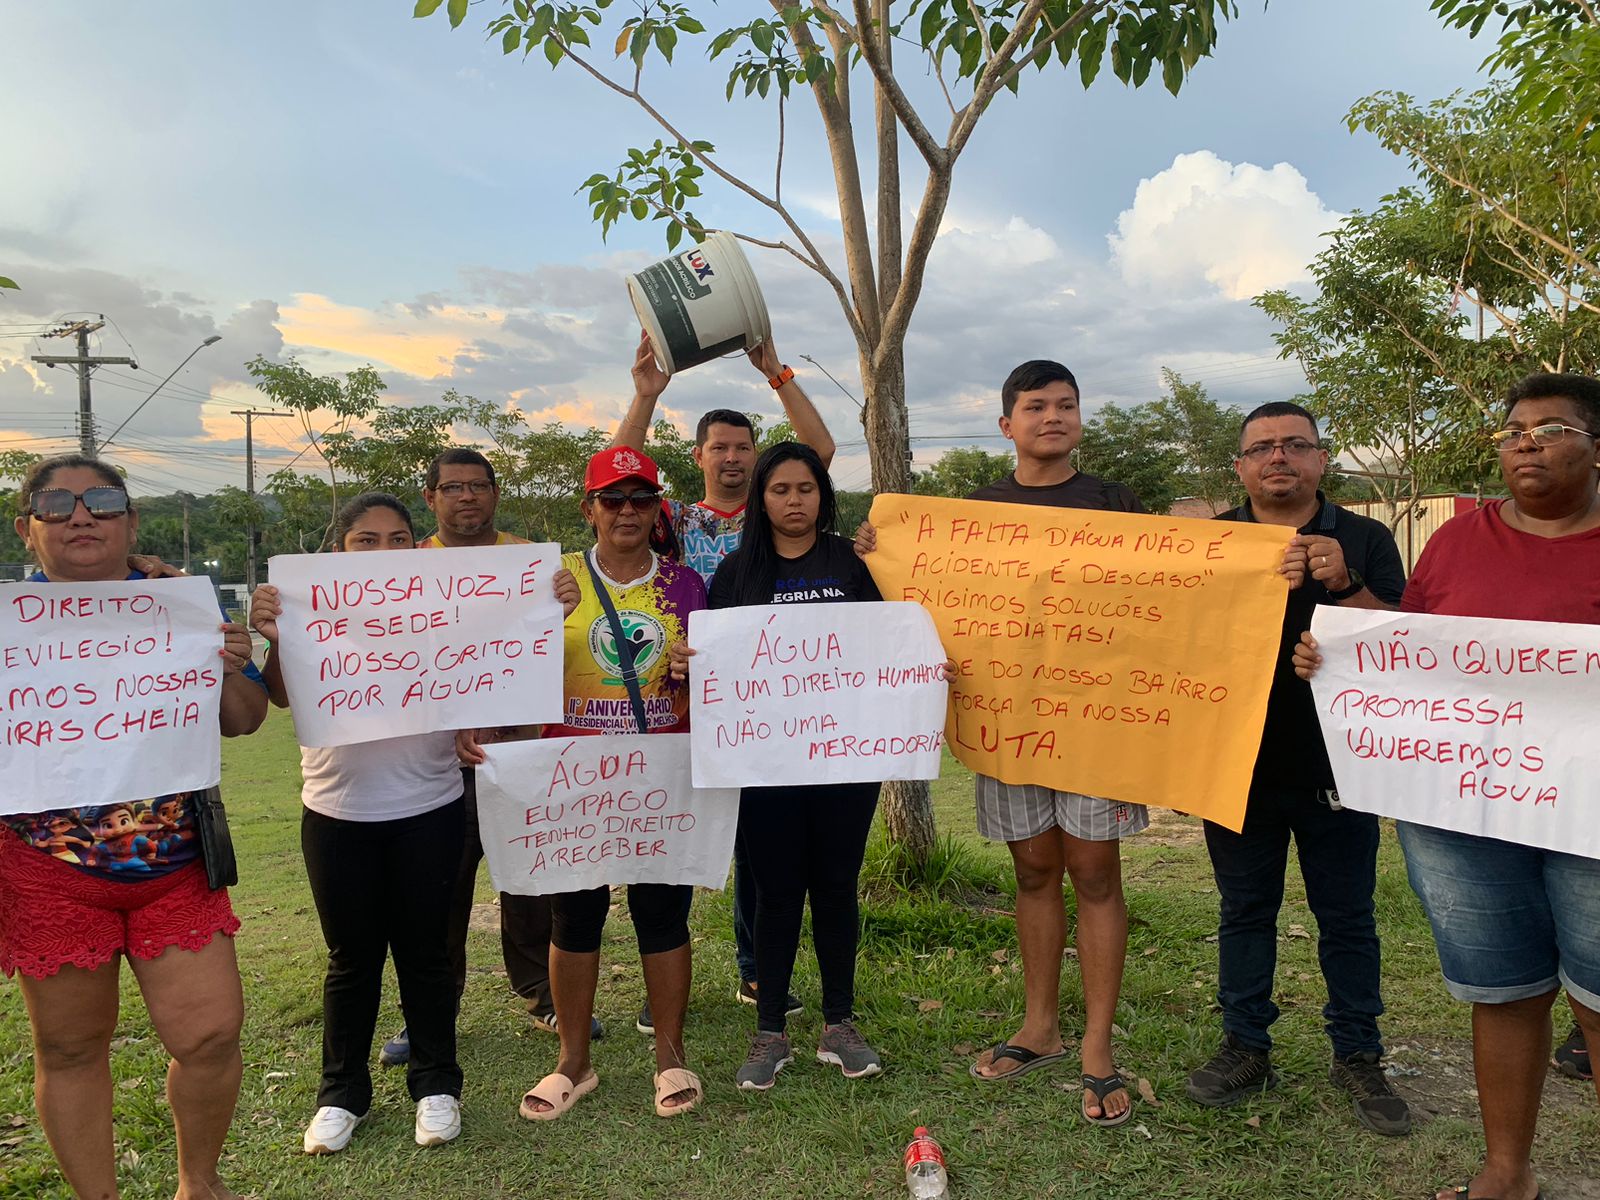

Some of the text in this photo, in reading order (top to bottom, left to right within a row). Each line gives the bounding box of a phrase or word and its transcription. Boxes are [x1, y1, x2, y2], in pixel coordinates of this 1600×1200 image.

[687, 249, 714, 281] LUX
[950, 518, 1029, 546] FALTA
[1044, 522, 1124, 548] D'ÁGUA
[1134, 528, 1195, 554] NÃO
[1206, 530, 1233, 560] É
[311, 559, 543, 612] NOSSA VOZ, É
[912, 551, 1038, 584] ACIDENTE,
[1051, 558, 1070, 583] É
[770, 587, 845, 604] EGRIA NA
[903, 580, 1025, 614] EXIGIMOS
[306, 605, 461, 643] DE SEDE!
[751, 614, 842, 669] ÁGUA
[953, 616, 1114, 645] IMEDIATAS!
[320, 630, 554, 682] NOSSO GRITO É
[1356, 629, 1438, 673] NÃO
[0, 669, 217, 711] MOS NOSSAS
[317, 684, 385, 716] POR
[702, 663, 945, 704] É UM DIREITO HUMANO
[988, 660, 1023, 679] DO
[1033, 664, 1113, 686] NOSSO
[1128, 670, 1228, 703] BAIRRO
[94, 697, 200, 741] CHEIA
[575, 717, 625, 729] RESIDENCIAL
[953, 690, 1170, 727] FORÇA DA NOSSA
[1330, 689, 1524, 727] PROMESSA
[717, 710, 837, 748] NÃO UMA
[956, 711, 1061, 760] LUTA.
[1347, 726, 1544, 772] QUEREMOS
[526, 789, 668, 825] EU PAGO
[508, 813, 695, 849] TENHO DIREITO
[529, 837, 668, 875] A RECEBER
